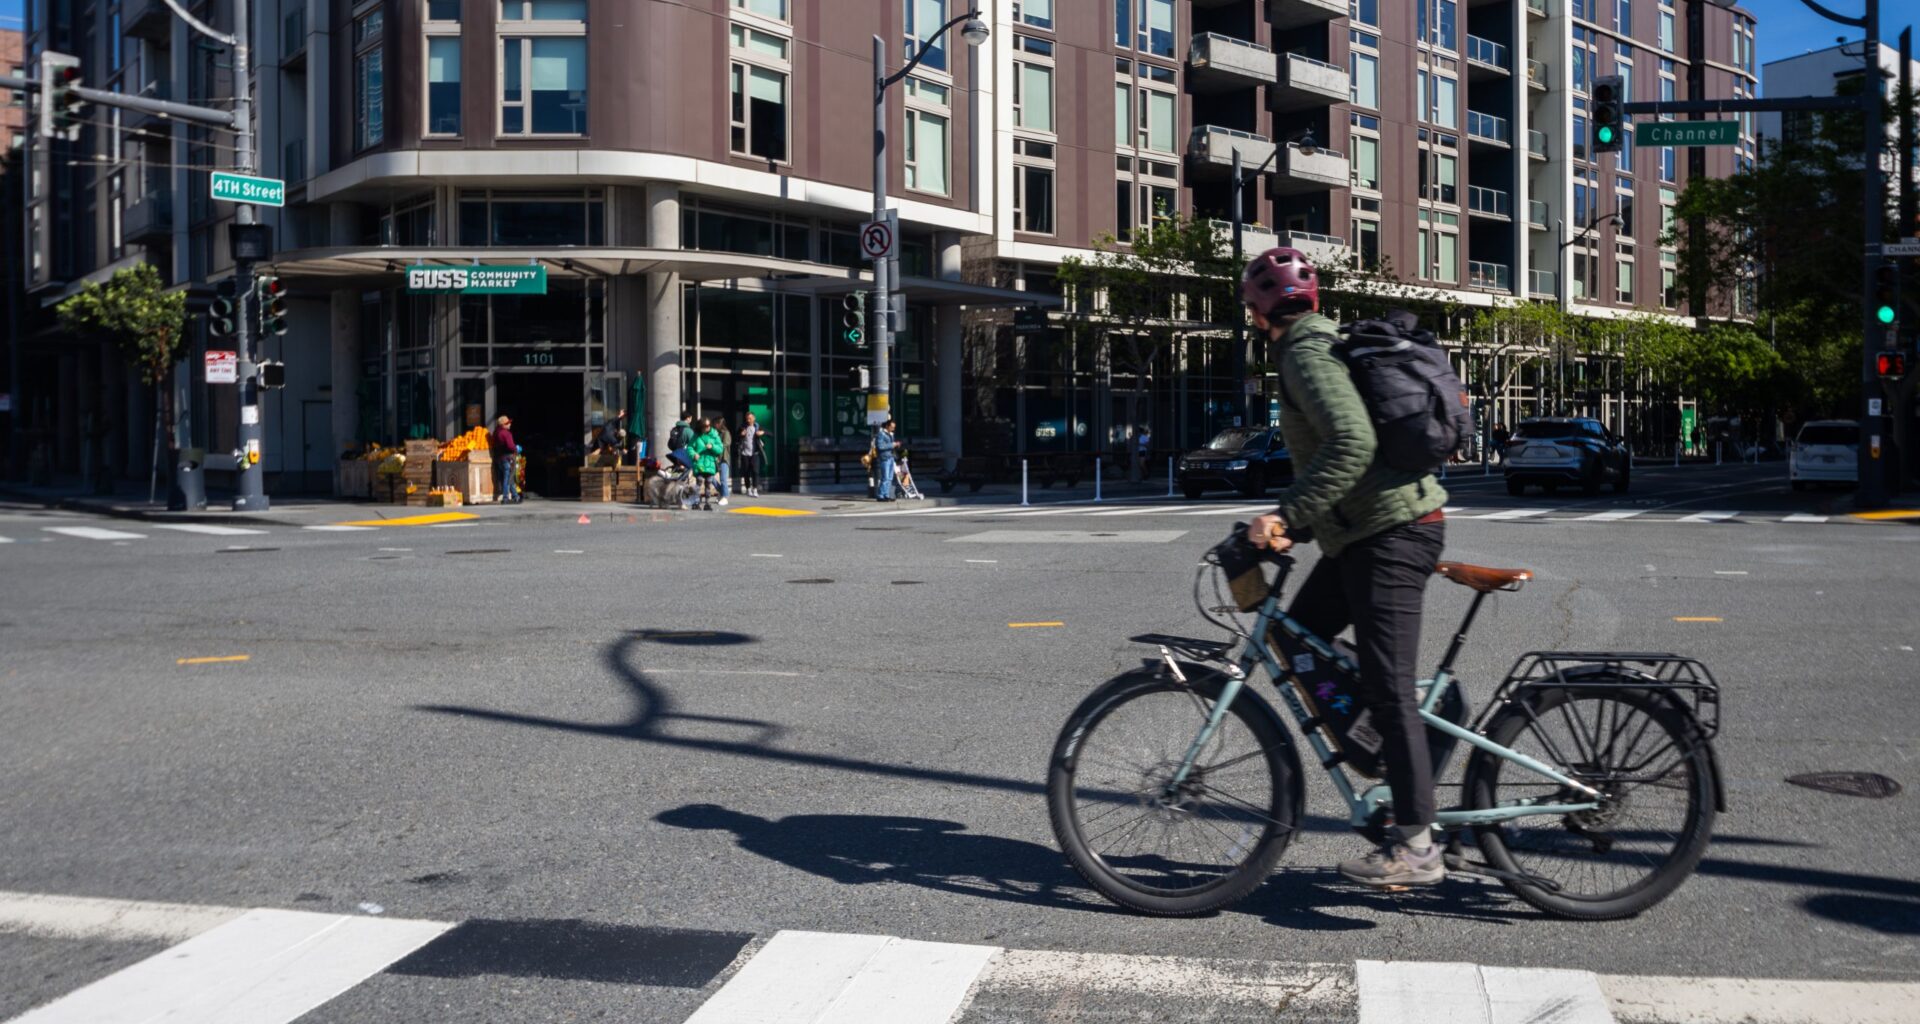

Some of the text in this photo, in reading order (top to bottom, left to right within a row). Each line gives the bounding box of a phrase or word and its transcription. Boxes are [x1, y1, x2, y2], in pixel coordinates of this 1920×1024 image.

[1651, 127, 1724, 141] Channel
[214, 179, 282, 200] 4TH Street
[470, 271, 537, 279] COMMUNITY
[470, 279, 517, 287] MARKET
[524, 353, 554, 365] 1101
